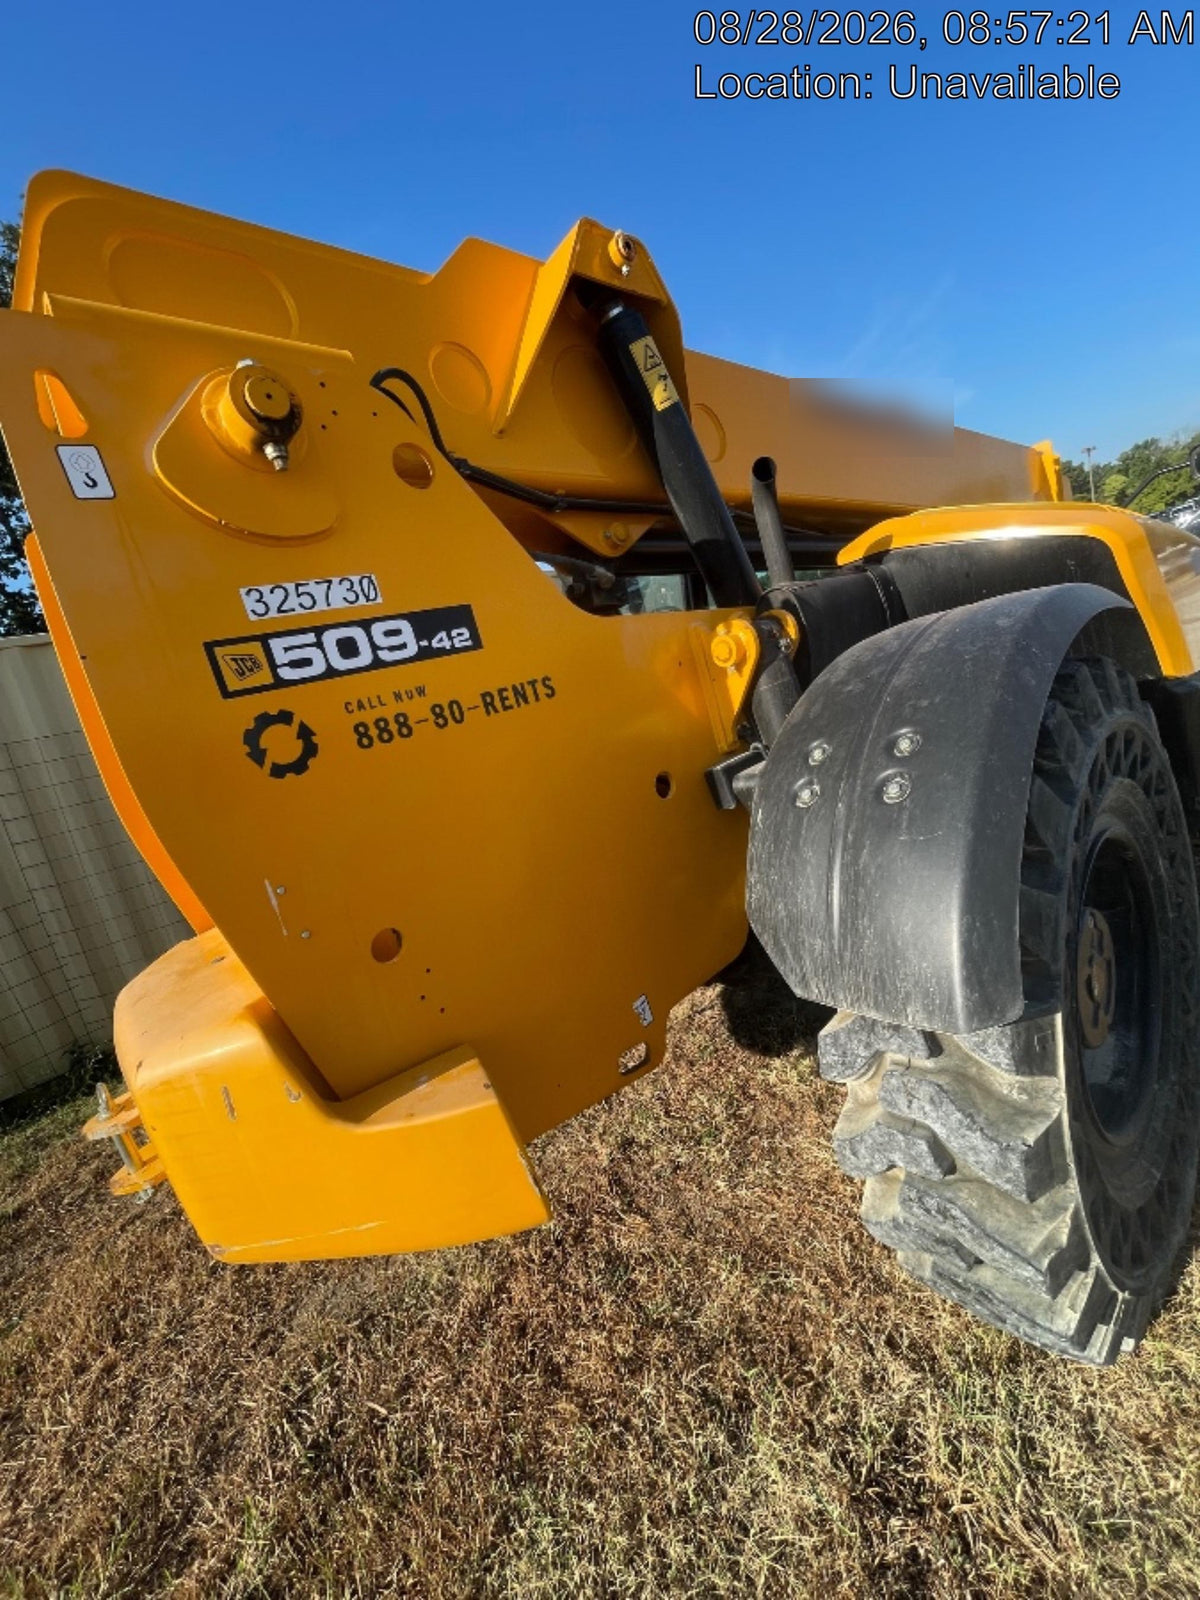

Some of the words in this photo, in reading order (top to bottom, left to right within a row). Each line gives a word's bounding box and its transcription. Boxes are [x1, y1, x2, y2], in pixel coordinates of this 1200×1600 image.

[244, 575, 379, 617] 325730
[228, 655, 264, 681] JCB
[343, 694, 387, 714] CALL
[392, 684, 427, 704] NOW
[352, 675, 556, 749] 888-80-RENTS
